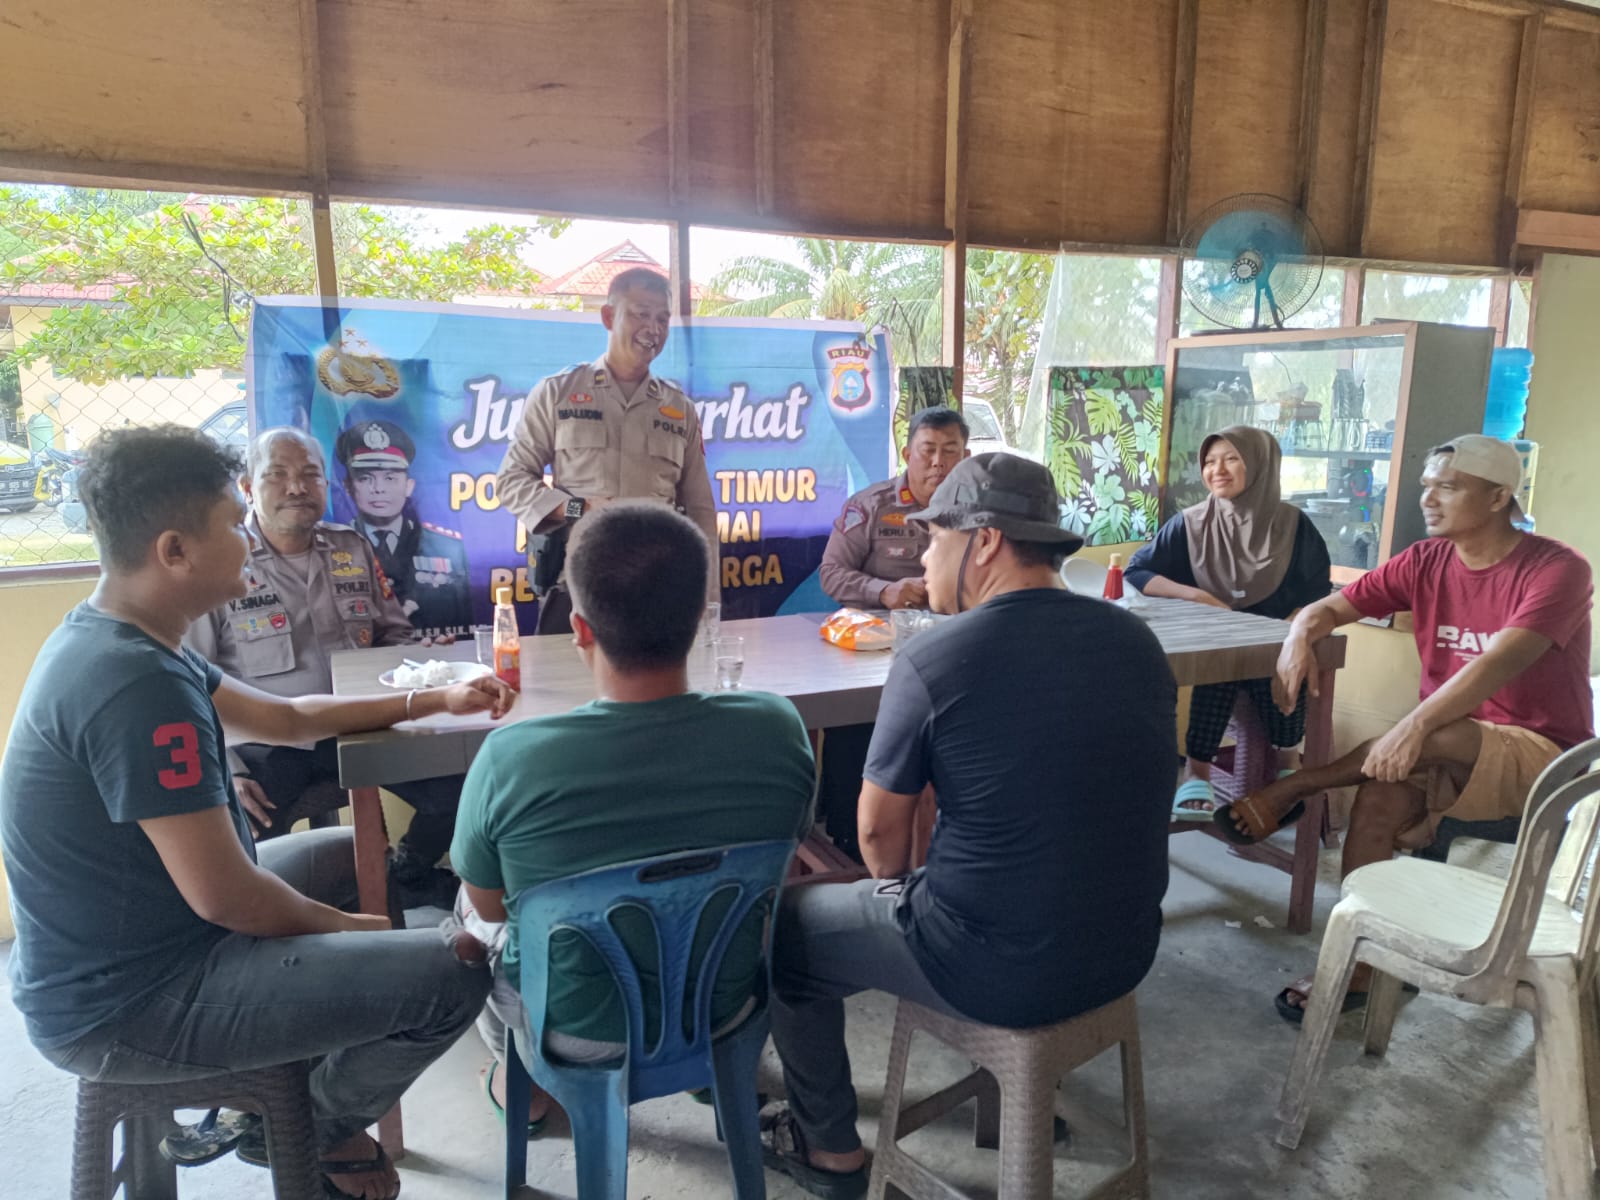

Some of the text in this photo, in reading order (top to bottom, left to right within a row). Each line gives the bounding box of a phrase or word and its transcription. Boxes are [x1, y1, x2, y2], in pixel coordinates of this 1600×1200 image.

[831, 349, 865, 358] RIAU
[452, 379, 526, 449] Ju
[450, 469, 816, 511] PO TIMUR
[716, 510, 761, 543] MAI
[335, 581, 370, 594] POLRI
[490, 554, 784, 603] BE RGA
[153, 722, 203, 790] 3
